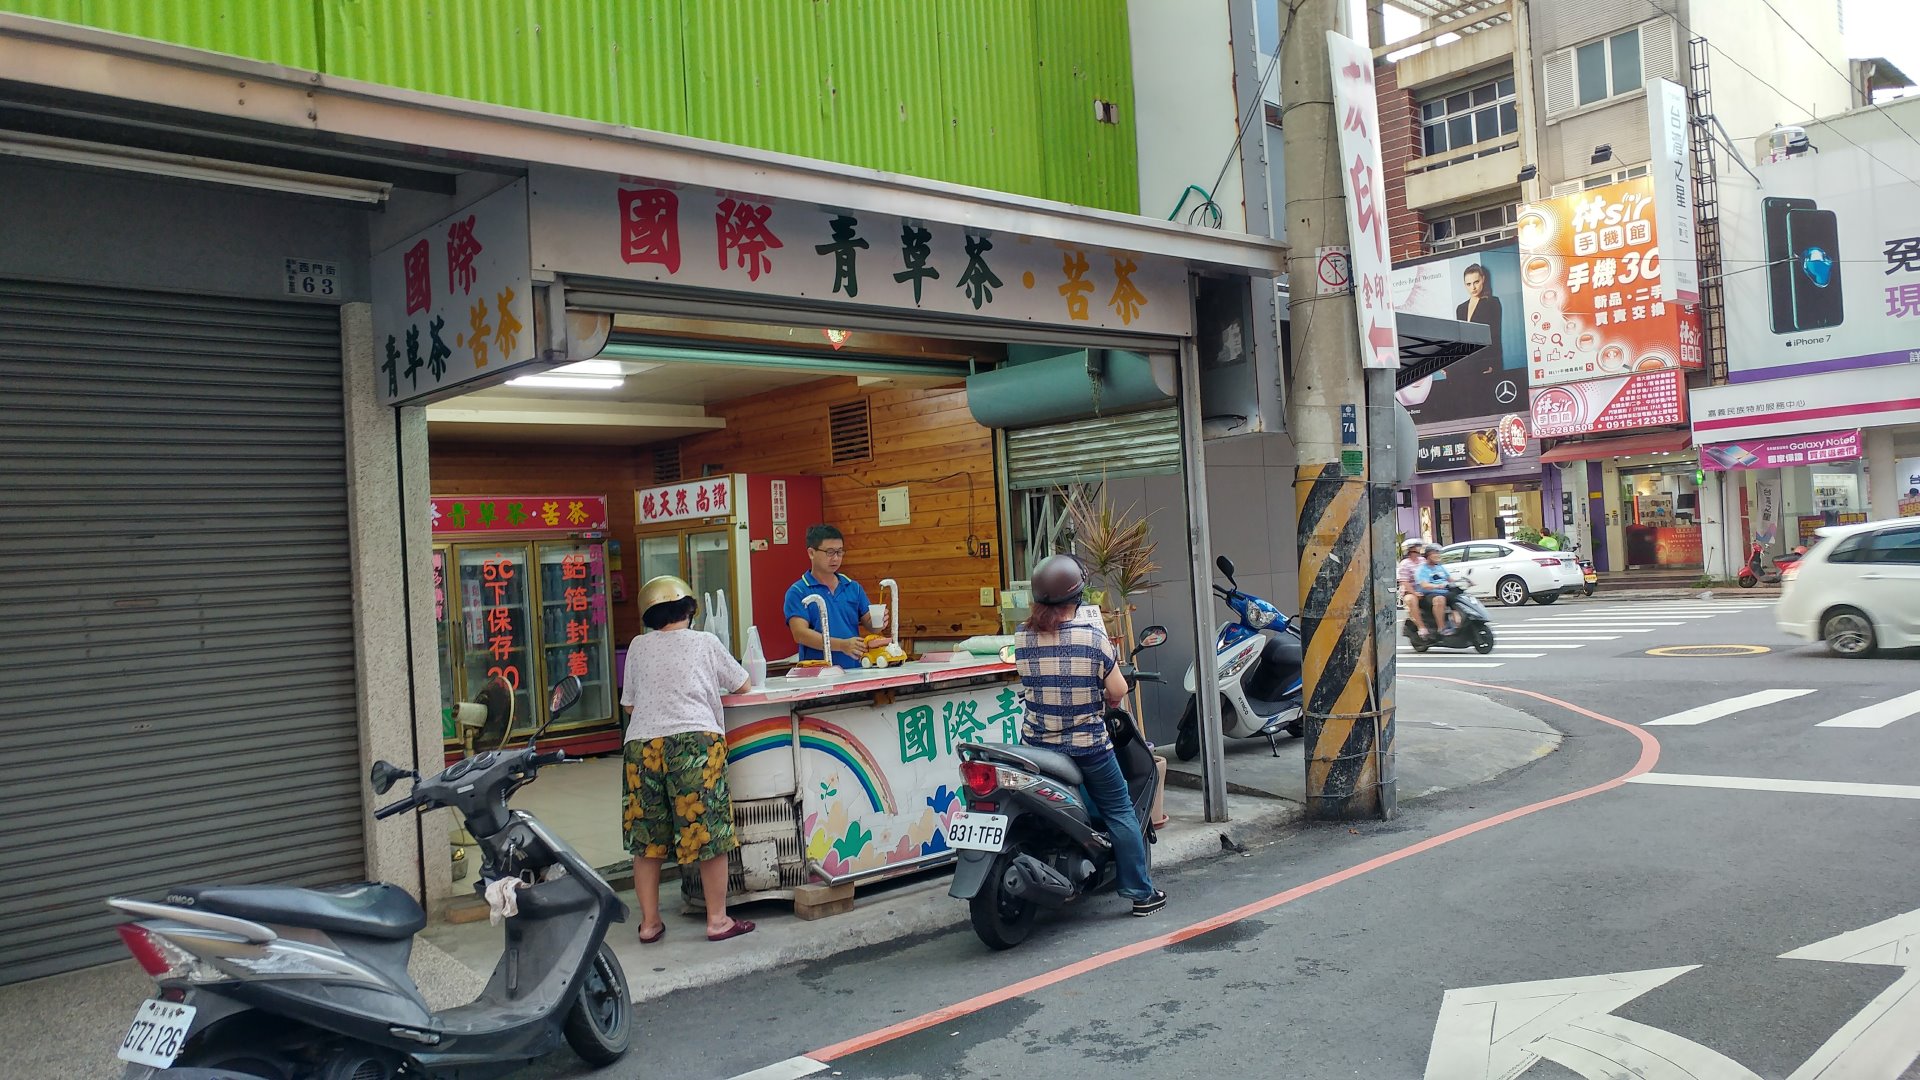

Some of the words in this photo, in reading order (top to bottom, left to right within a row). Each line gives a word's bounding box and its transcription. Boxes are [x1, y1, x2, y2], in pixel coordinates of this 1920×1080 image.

[1578, 223, 1647, 251] 手機館
[299, 262, 336, 275] 西門街
[404, 215, 482, 316] 國際
[303, 276, 334, 295] 63
[1595, 303, 1666, 326] 買賣交換
[382, 286, 523, 398] 青草茶·苦茶
[1793, 336, 1825, 347] iPhone
[1826, 334, 1832, 343] 7
[1537, 397, 1572, 415] 林sir
[1342, 423, 1355, 433] 7A
[1535, 423, 1594, 436] 05-2288508
[1606, 414, 1679, 430] 0915-123333
[1789, 440, 1825, 451] Galaxy
[1826, 435, 1856, 447] Note8
[1238, 696, 1248, 716] KYMCO
[167, 894, 195, 906] KYMCO
